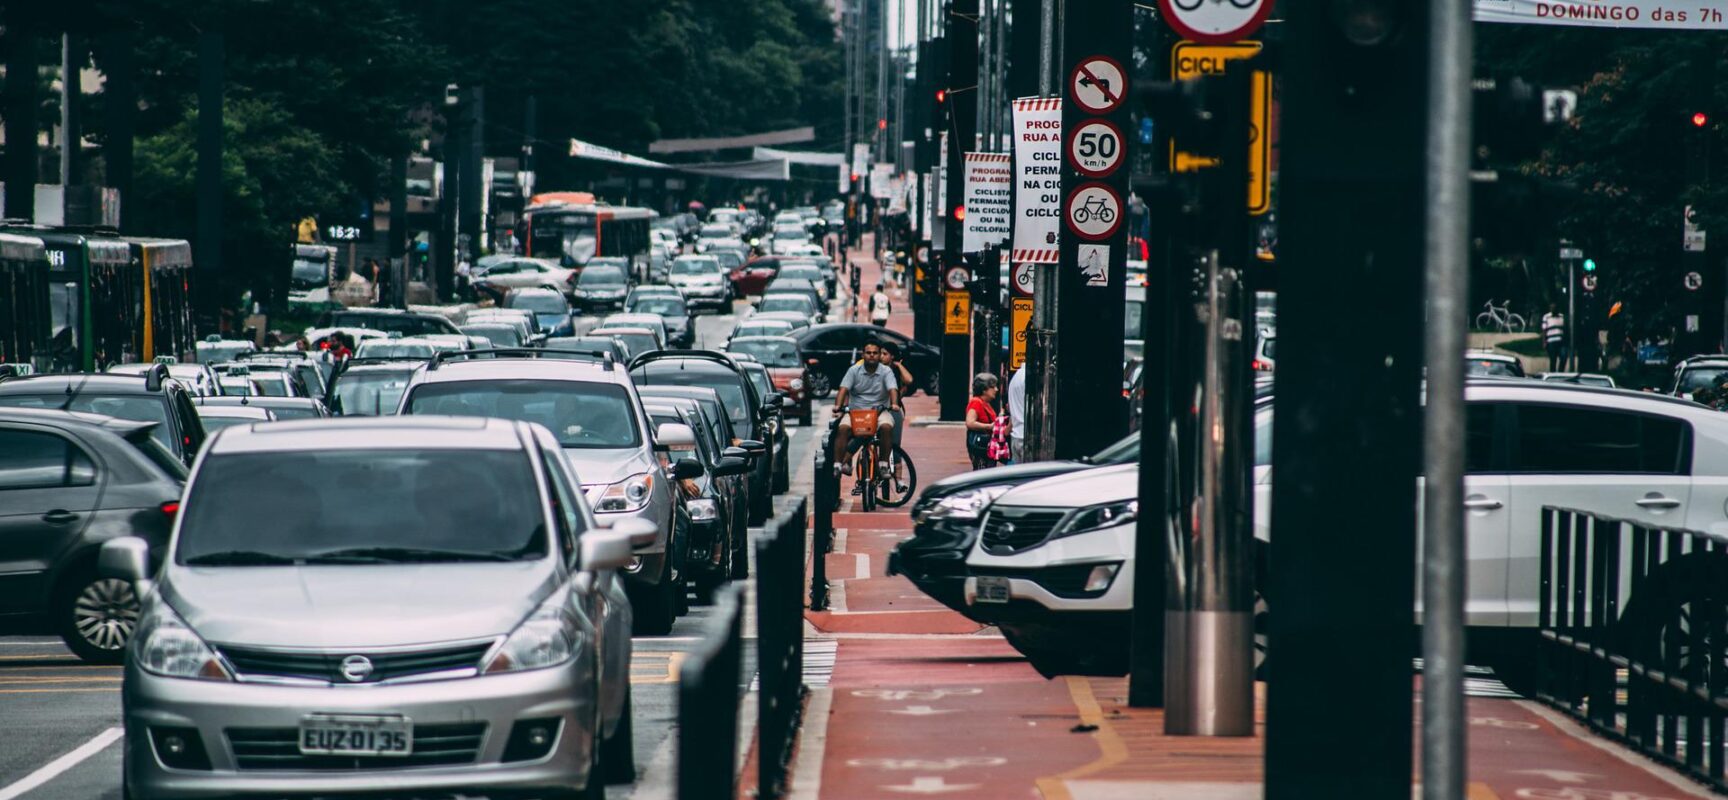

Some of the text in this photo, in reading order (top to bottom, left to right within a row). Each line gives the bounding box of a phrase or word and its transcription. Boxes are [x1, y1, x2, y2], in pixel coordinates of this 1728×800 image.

[1536, 3, 1723, 23] DOMINGO das 7h
[1023, 133, 1048, 142] RUA
[1079, 132, 1116, 159] 50
[1032, 152, 1061, 161] CICL
[1084, 159, 1107, 167] km/h
[1023, 180, 1041, 189] NA
[969, 197, 1010, 205] PERMANE
[1041, 194, 1058, 203] OU
[1014, 303, 1033, 312] CICL
